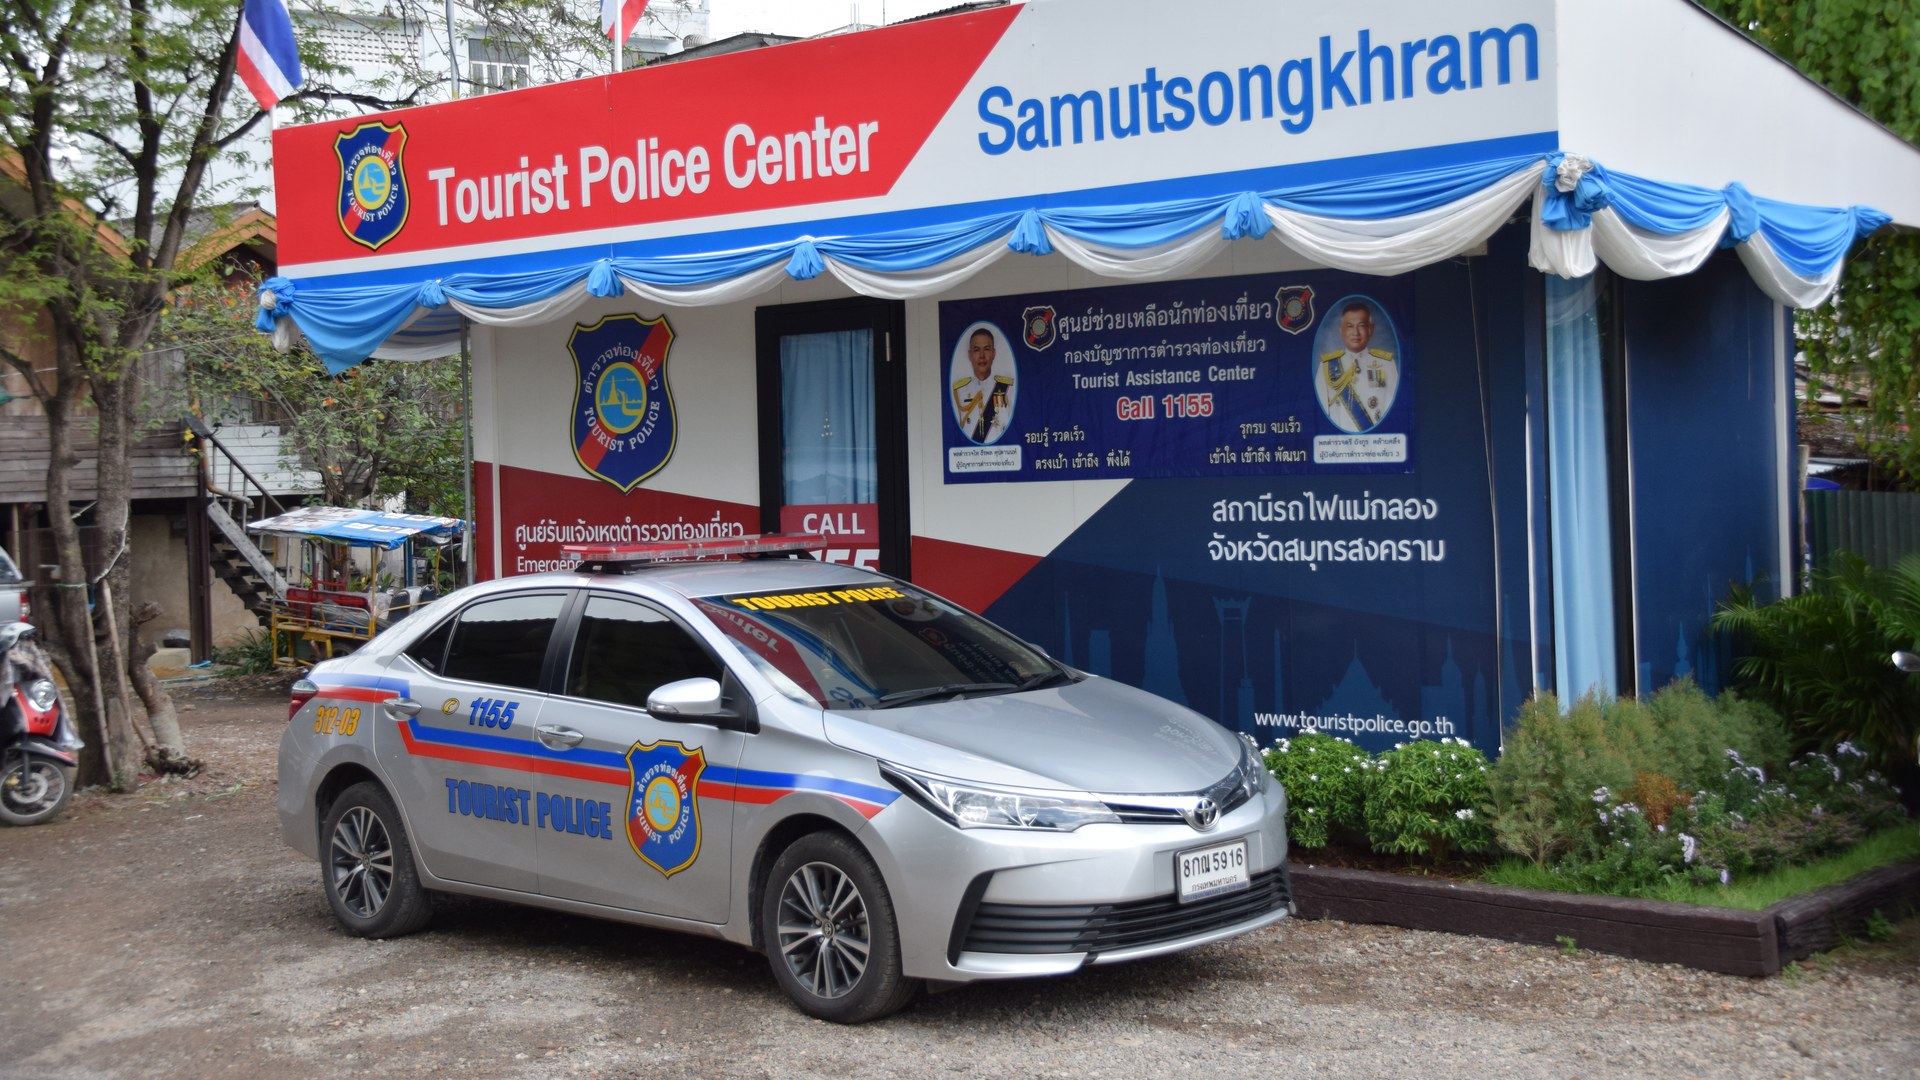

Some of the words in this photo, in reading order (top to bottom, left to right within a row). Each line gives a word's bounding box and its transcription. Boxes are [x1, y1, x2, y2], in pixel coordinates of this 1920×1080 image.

[977, 22, 1540, 156] Samutsongkhram
[428, 155, 569, 226] Tourist
[580, 137, 710, 208] Police
[723, 116, 879, 190] Center
[347, 189, 375, 222] TOURIST
[377, 183, 399, 220] POLICE
[1058, 292, 1272, 340] ศูนย์ช่วยเหลือนักท่องเที่ยว
[1064, 331, 1266, 366] กองบัญชาการตำรวจท่องเที่ยว
[583, 342, 659, 394] ตำรวจท่องเที่ยว
[1072, 371, 1119, 389] Tourist
[1125, 368, 1201, 387] Assistance
[1208, 365, 1256, 382] Center
[1116, 395, 1155, 421] Call
[1162, 393, 1213, 418] 1155
[584, 406, 624, 452] TOURIST
[629, 401, 661, 450] POLICE
[1024, 427, 1049, 447] รอบรู้
[1052, 424, 1085, 442] รวดเร็ว
[1239, 422, 1266, 439] รุกรบ
[1270, 416, 1301, 434] จบเร็ว
[1072, 453, 1099, 469] เข้าถึง
[1209, 446, 1237, 464] เข้าใจ
[1241, 445, 1271, 463] เข้าถึง
[1275, 446, 1306, 463] พัฒนา
[1212, 490, 1438, 523] สถานีรถไฟแม่กลอง
[802, 511, 866, 535] CALL
[517, 555, 585, 572] Emergenc
[1207, 531, 1445, 571] จังหวัดสมุทรสงคราม
[731, 591, 842, 611] TOURIST
[839, 587, 904, 605] POLICE
[314, 705, 362, 736] 312-03
[468, 696, 520, 730] 1155
[1254, 710, 1455, 738] www.touristpolice.go.th
[444, 778, 531, 826] TOURIST
[536, 792, 613, 841] POLICE
[635, 797, 663, 844] TOURIST
[668, 804, 690, 845] POLICE
[1183, 855, 1210, 878] 8กณ
[1214, 848, 1244, 871] 5916
